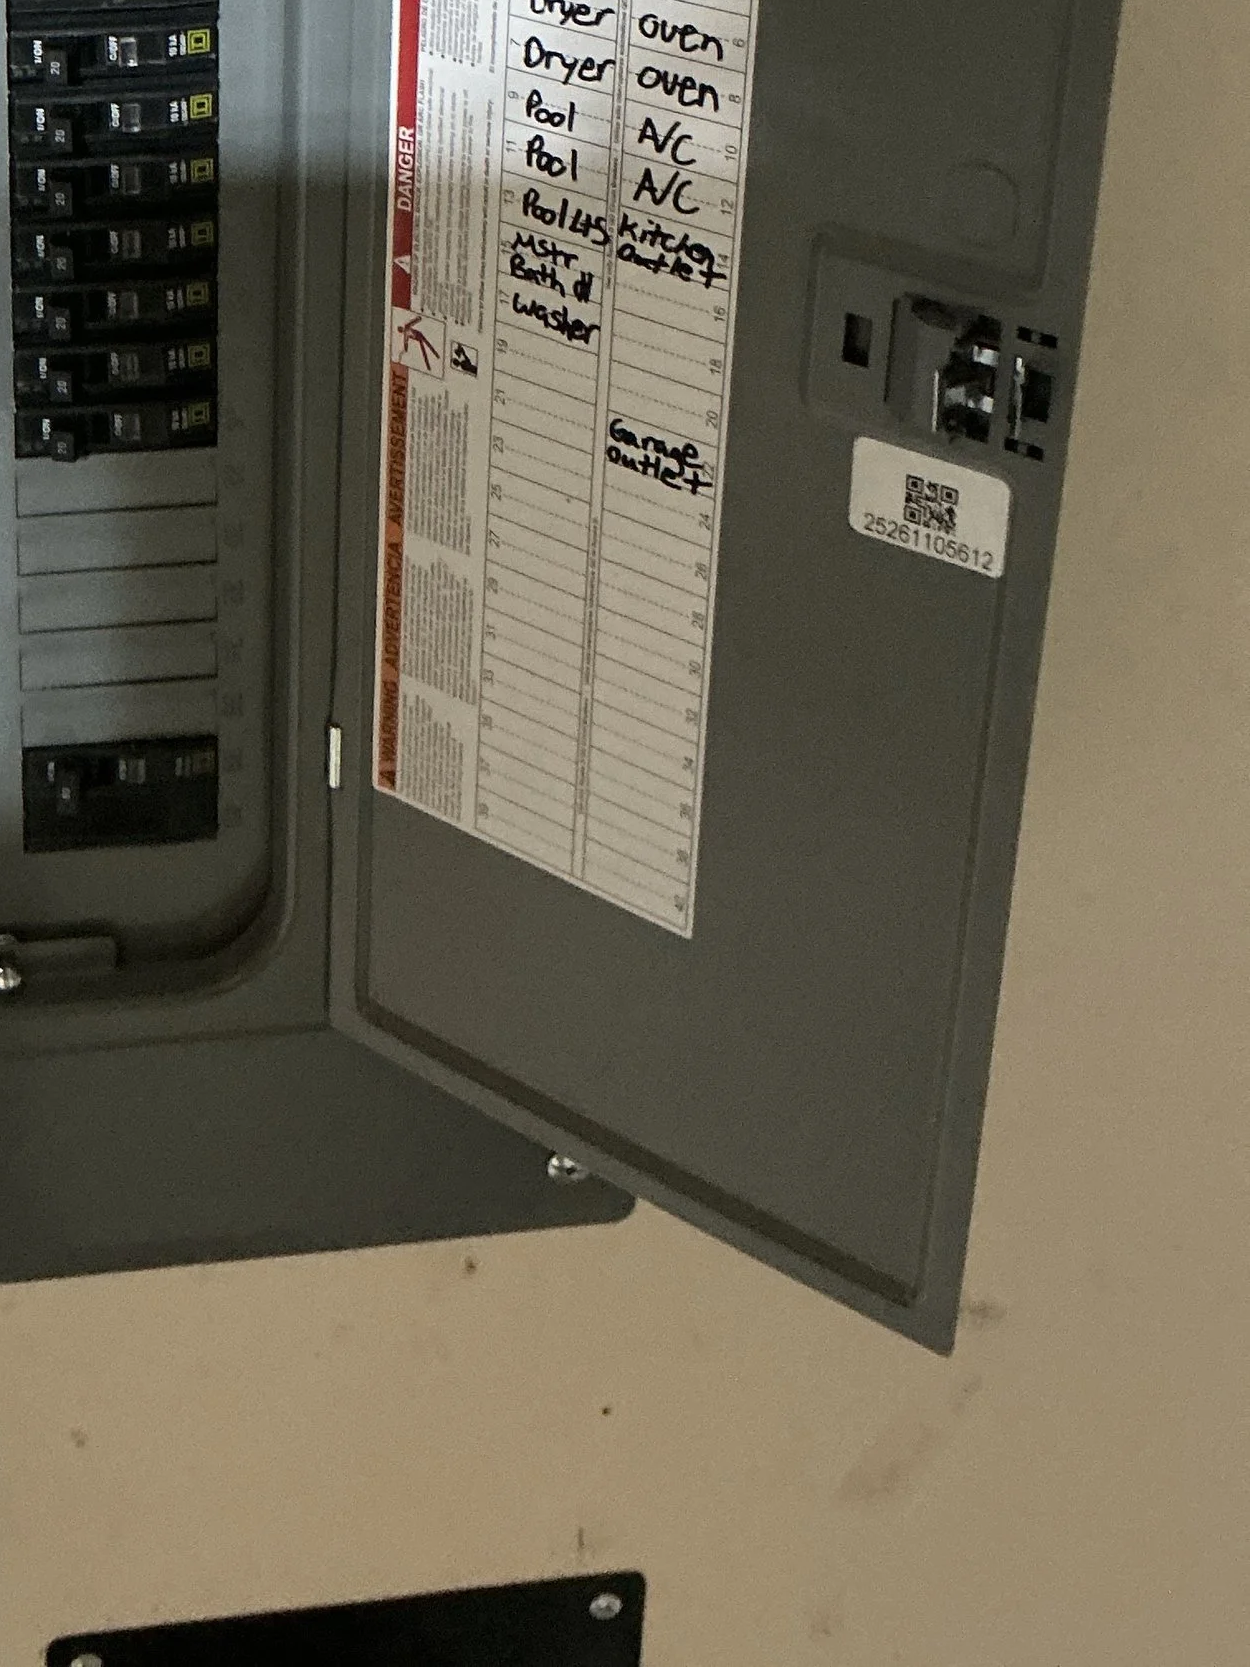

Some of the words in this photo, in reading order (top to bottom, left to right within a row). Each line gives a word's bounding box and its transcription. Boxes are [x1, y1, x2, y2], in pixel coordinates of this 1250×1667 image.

[511, 38, 521, 48] 7
[732, 37, 745, 48] 6
[50, 61, 61, 76] 20
[524, 36, 616, 84] Dryer
[508, 89, 519, 100] 9
[728, 92, 741, 104] 8
[526, 89, 575, 132] Pool
[55, 129, 65, 143] 20
[638, 117, 697, 165] A/C
[506, 139, 517, 154] 11
[724, 144, 737, 162] 10
[526, 134, 578, 181] Pool
[397, 126, 413, 212] DANGER
[55, 192, 65, 206] 20
[633, 168, 700, 214] A/C
[522, 187, 568, 229] Pool
[721, 197, 733, 216] 12
[717, 252, 729, 271] 14
[509, 253, 565, 298] Bath
[500, 290, 510, 306] 17
[713, 305, 725, 323] 16
[497, 337, 508, 356] 19
[709, 357, 722, 376] 18
[495, 388, 506, 405] 21
[706, 408, 718, 429] 20
[387, 371, 408, 527] AVERTISSEMENT
[493, 434, 504, 454] 23
[609, 418, 702, 474] Garage
[491, 482, 502, 501] 25
[698, 512, 710, 531] 24
[489, 529, 500, 548] 27
[862, 511, 994, 572] 25261105612
[383, 540, 403, 671] ADVERTENCIA
[379, 680, 399, 752] WARNING
